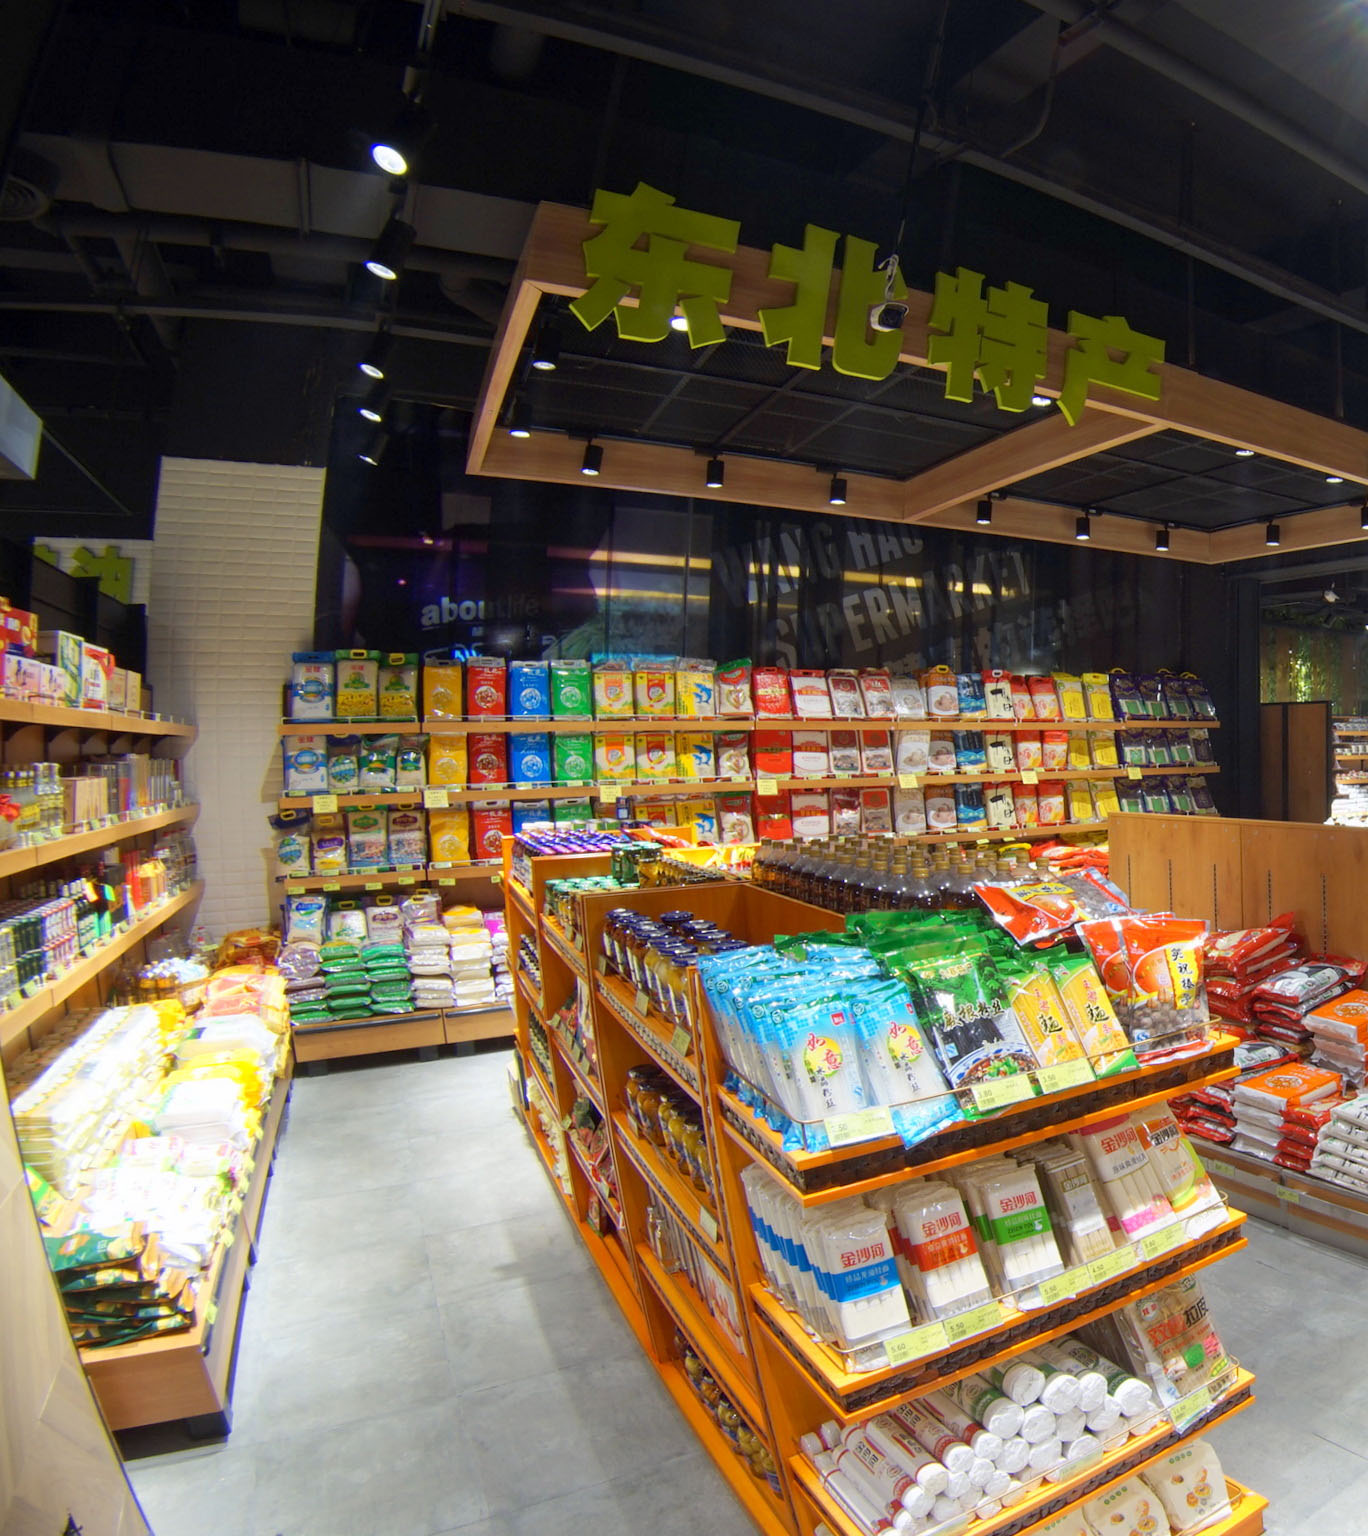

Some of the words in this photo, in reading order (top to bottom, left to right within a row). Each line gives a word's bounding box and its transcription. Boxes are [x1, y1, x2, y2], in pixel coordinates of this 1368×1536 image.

[568, 181, 1166, 426] 东北特产
[1100, 1127, 1138, 1155] 金沙河
[999, 1191, 1038, 1214] 金沙河
[921, 1212, 963, 1238] 金沙河
[840, 1242, 886, 1269] 金沙河
